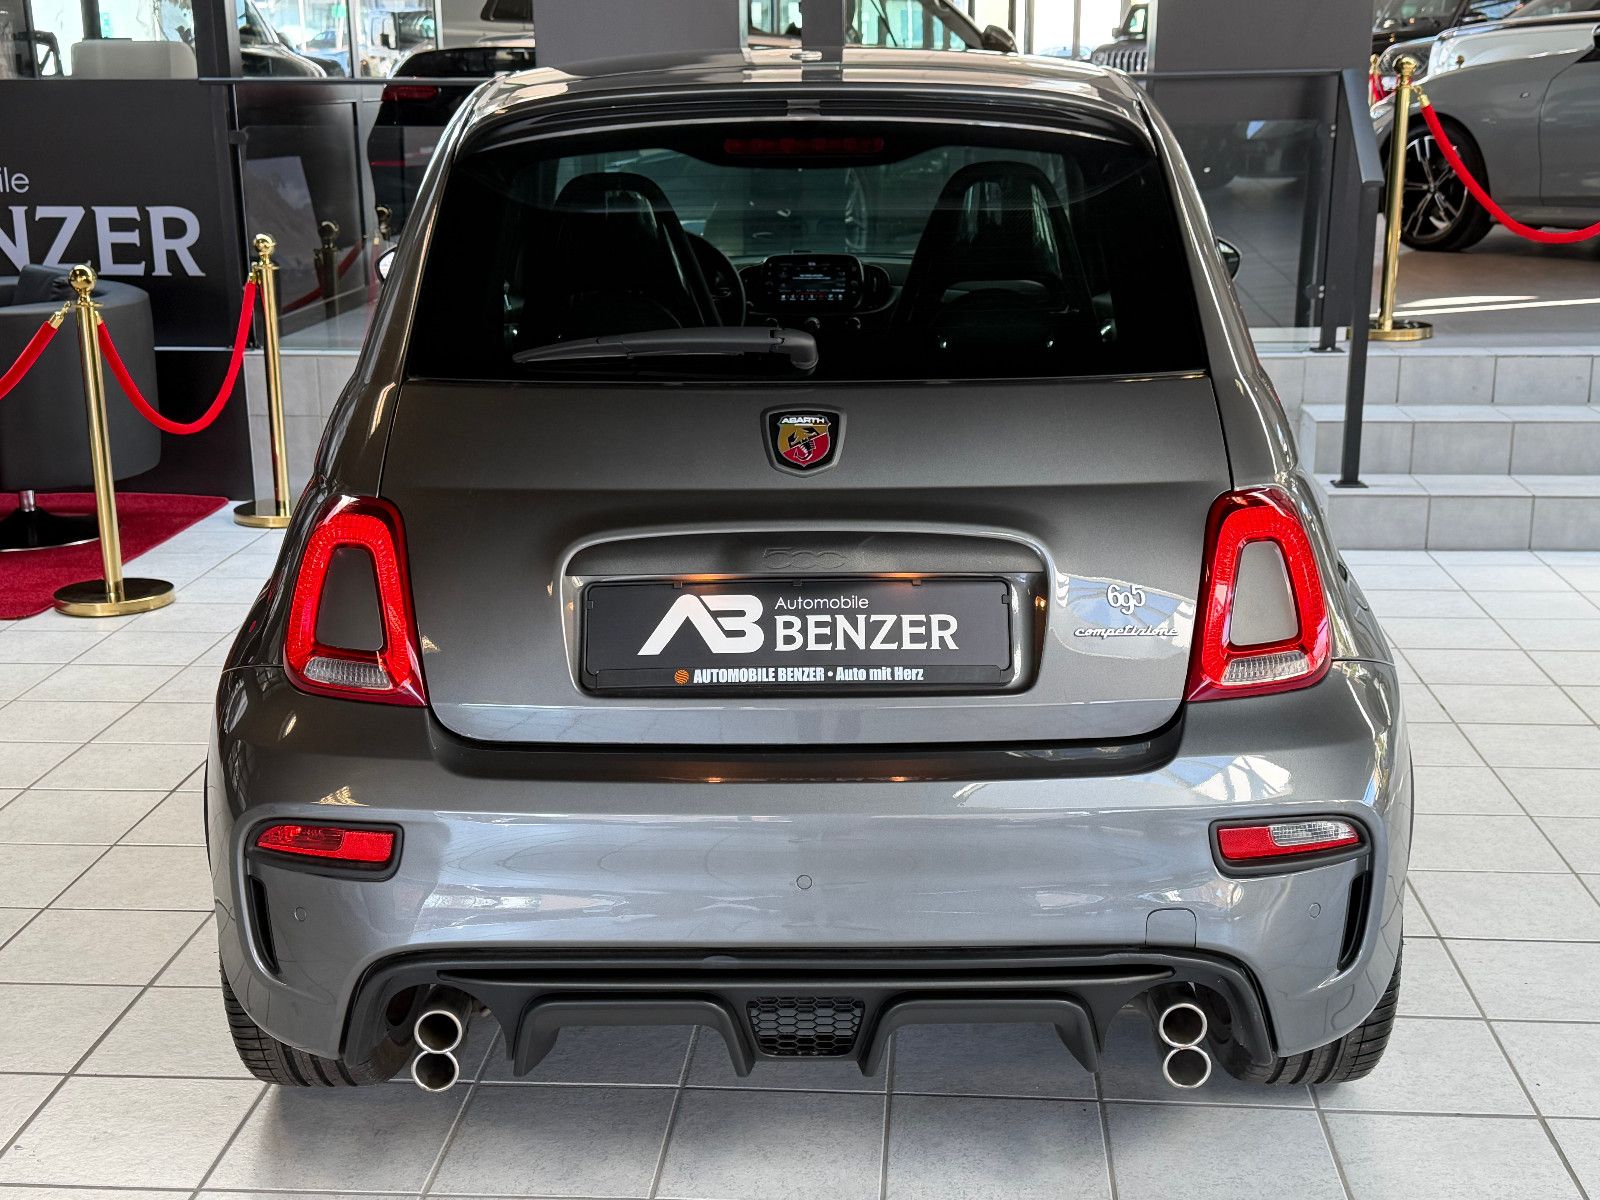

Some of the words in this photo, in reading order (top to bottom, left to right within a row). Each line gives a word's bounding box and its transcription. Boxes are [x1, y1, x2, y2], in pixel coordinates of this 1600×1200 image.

[781, 416, 825, 424] ABARTH
[762, 546, 849, 570] 500
[774, 595, 869, 610] Automobile
[774, 613, 960, 652] BENZER
[1074, 625, 1179, 640] competizione
[693, 667, 776, 684] AUTOMOBILE
[777, 666, 825, 682] BENZER
[835, 666, 867, 682] Auto
[869, 666, 893, 681] mit
[894, 666, 924, 681] Herz
